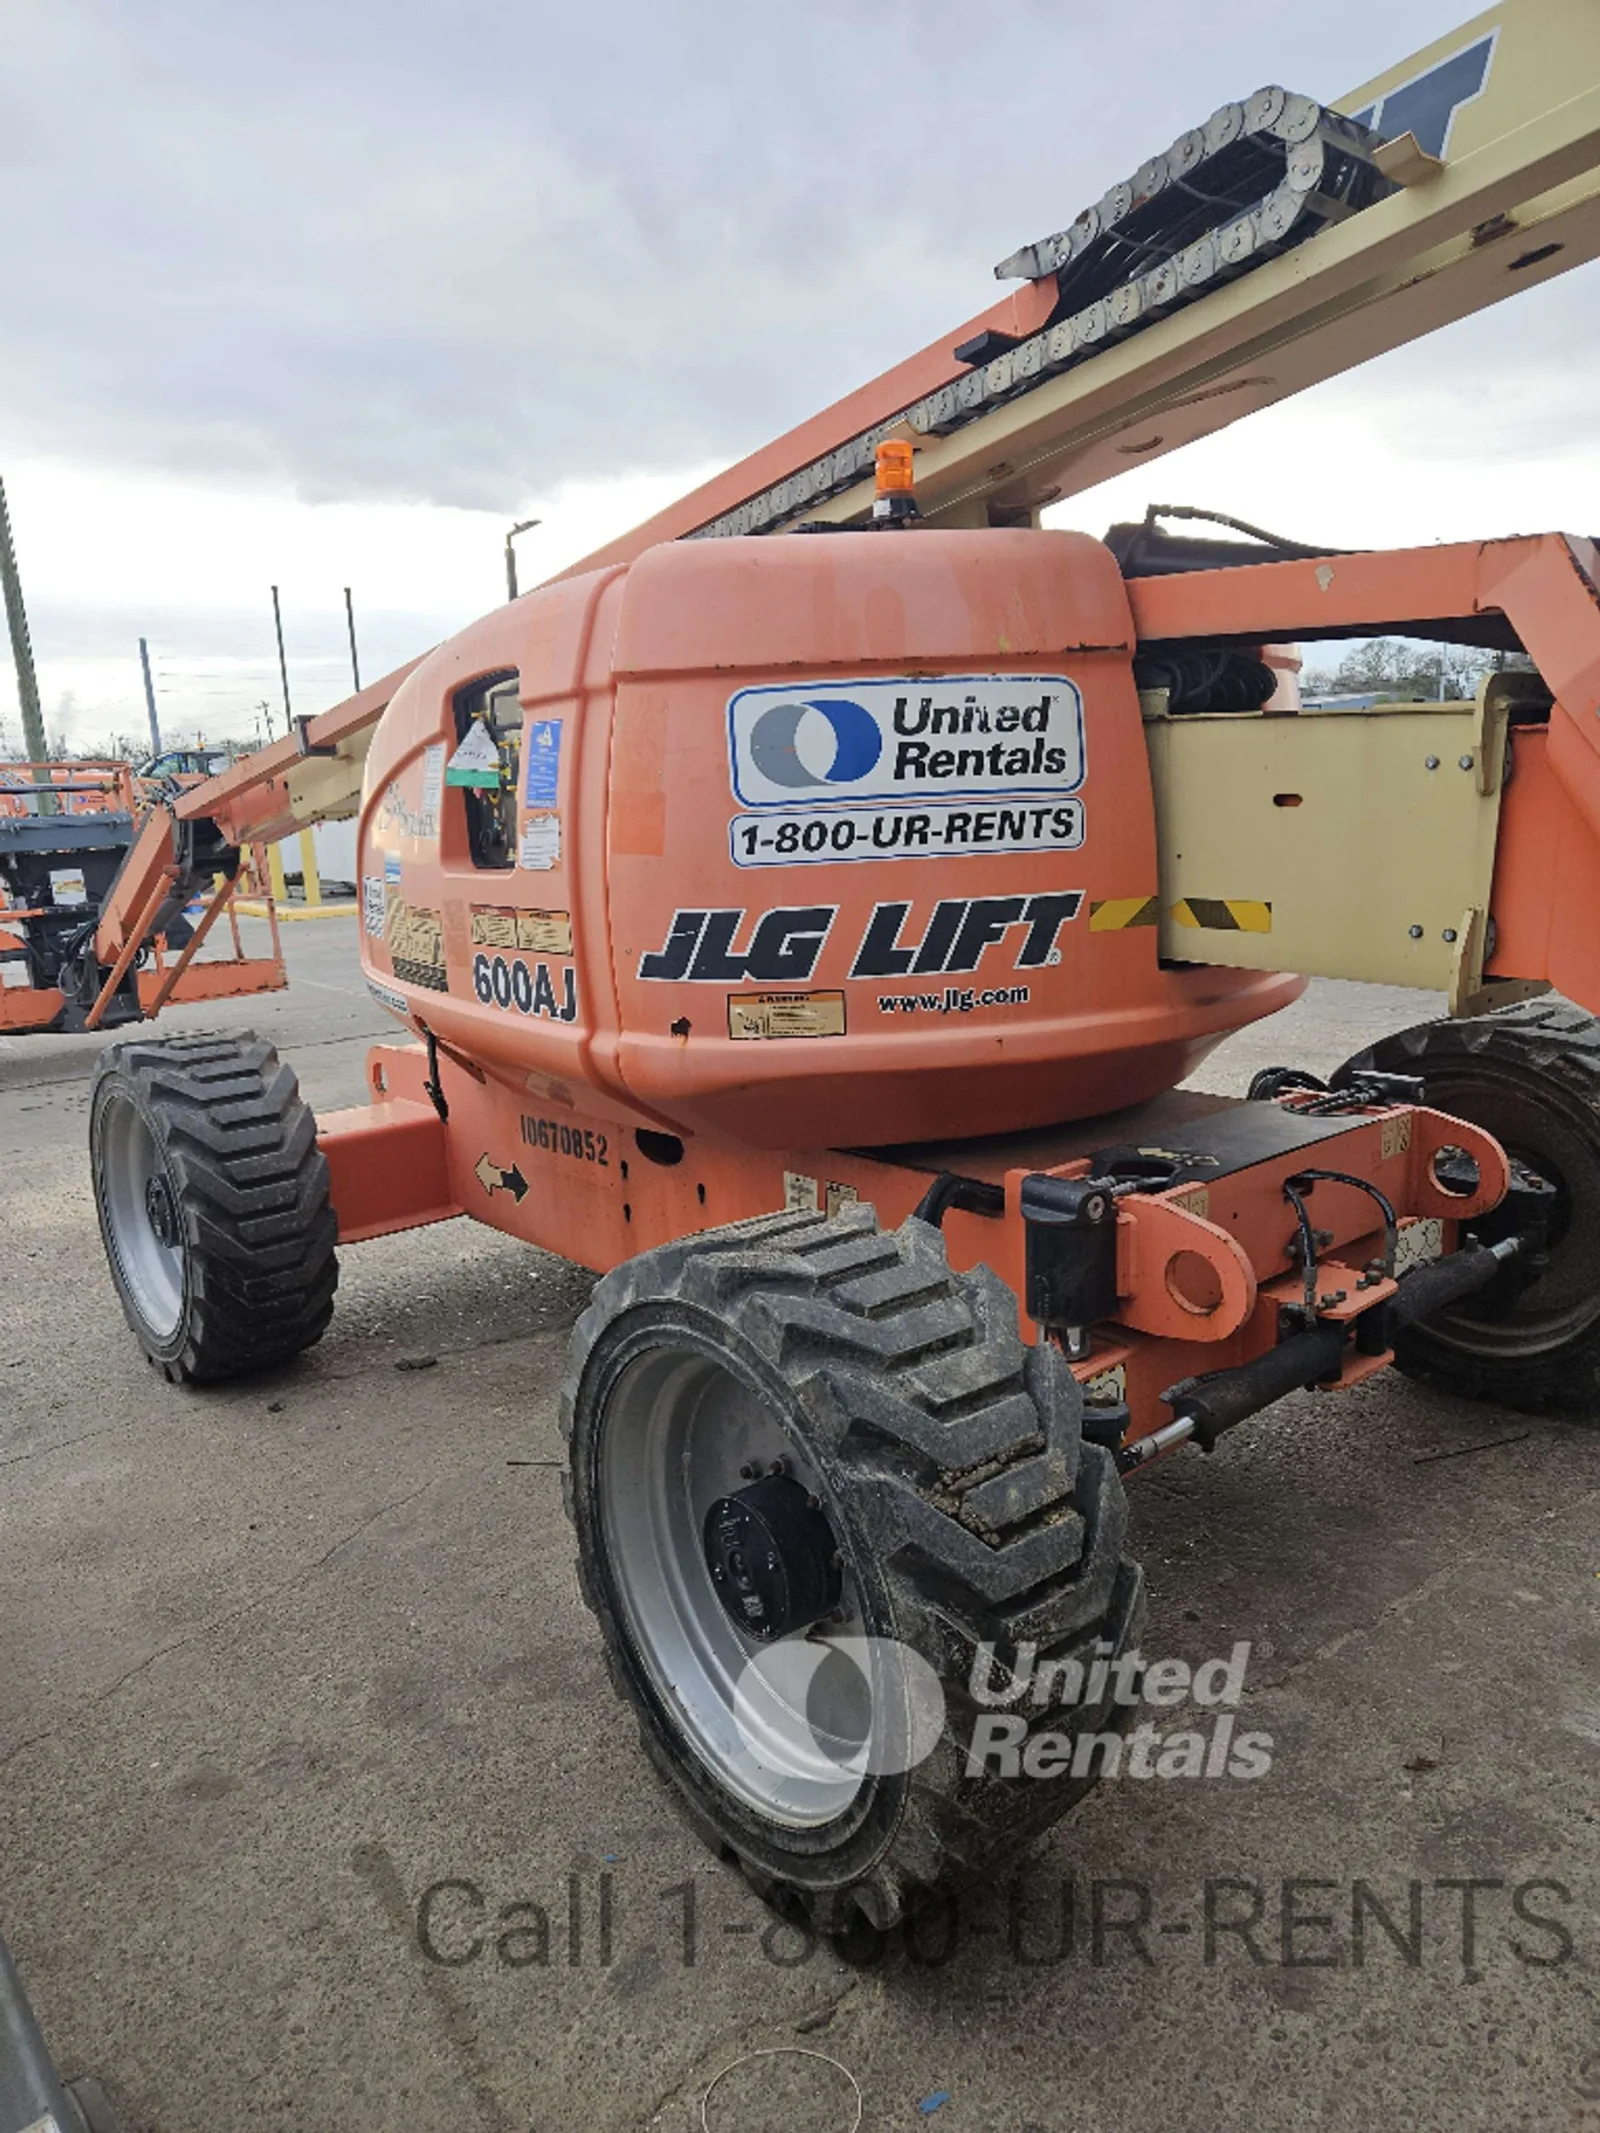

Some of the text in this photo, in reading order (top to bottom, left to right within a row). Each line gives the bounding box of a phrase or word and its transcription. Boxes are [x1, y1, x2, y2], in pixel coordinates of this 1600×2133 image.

[893, 738, 1067, 780] Rentals
[741, 808, 1076, 856] 1-800-UR-RENTS
[637, 905, 839, 982] JLG
[847, 891, 1085, 980] LIFT
[474, 952, 577, 1023] 600AJ
[878, 985, 1030, 1014] www.jlg.com
[520, 1114, 609, 1166] 10670852
